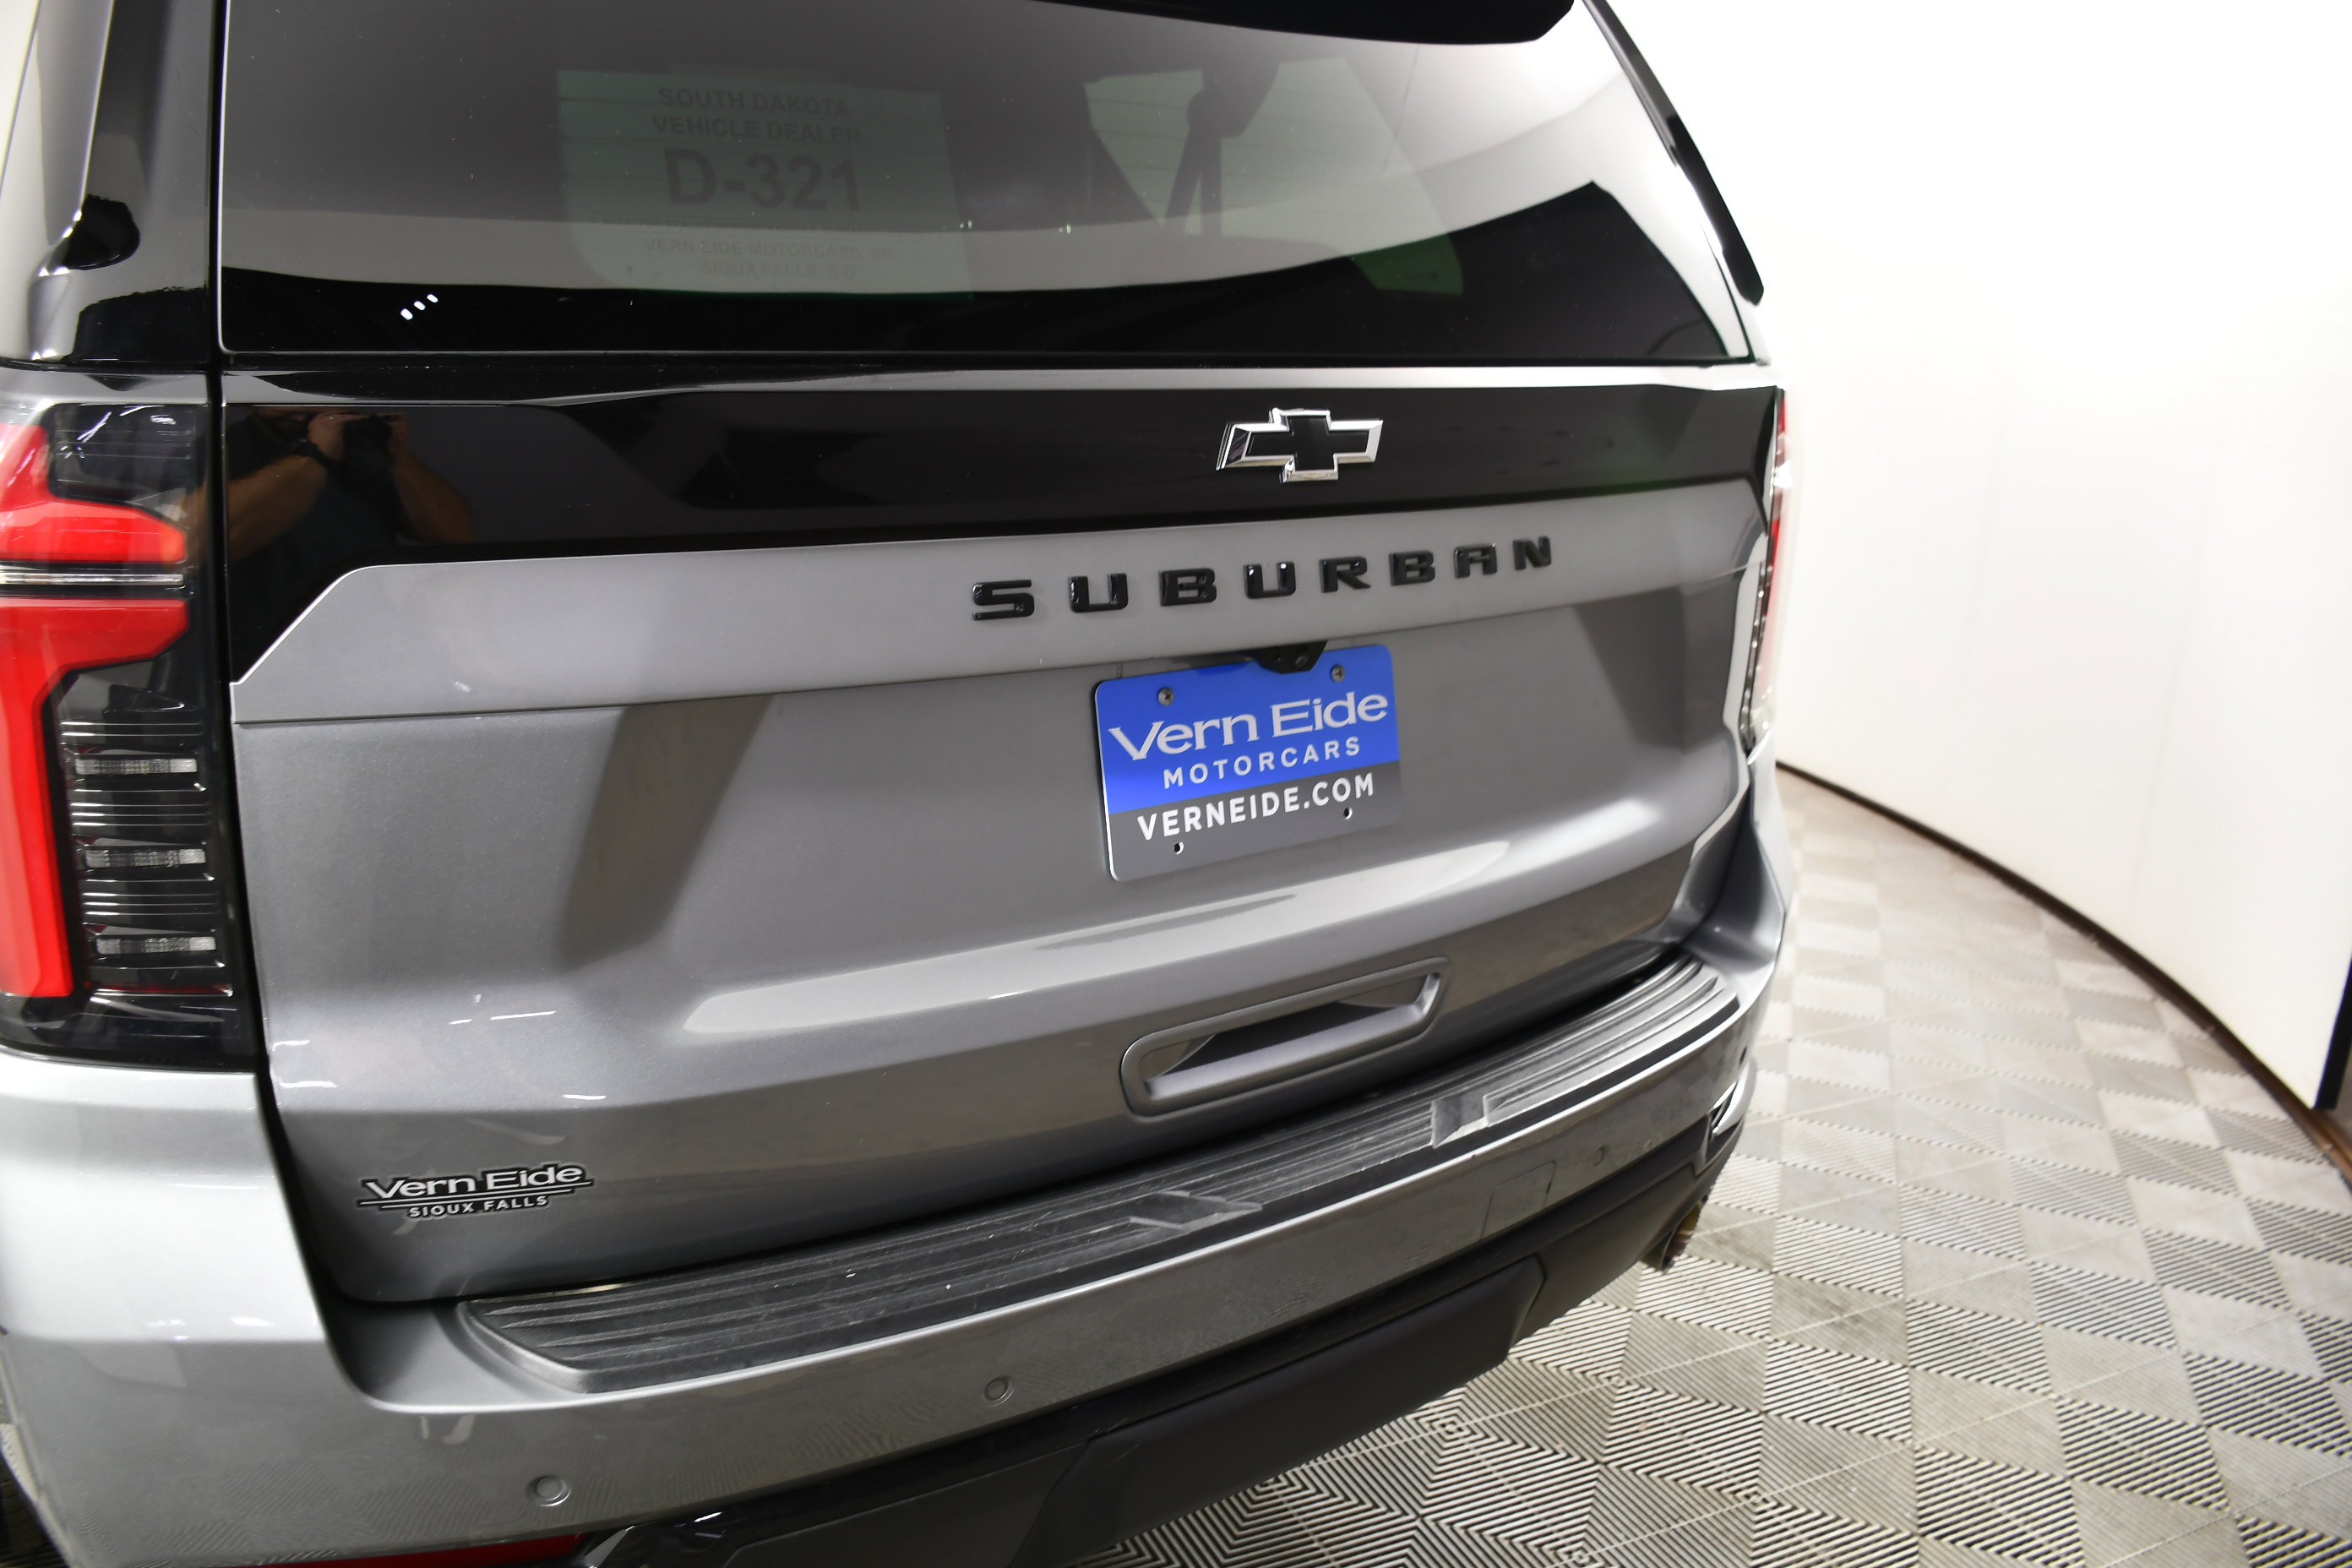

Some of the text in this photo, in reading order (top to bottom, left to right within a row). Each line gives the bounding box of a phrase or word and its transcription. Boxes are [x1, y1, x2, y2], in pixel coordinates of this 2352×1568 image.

[659, 87, 851, 117] SOUTH DAKOTA
[651, 115, 863, 145] VEHICLE DEALER
[663, 147, 859, 211] D-321
[643, 237, 696, 253] VERN
[701, 241, 743, 256] EIDE
[700, 261, 754, 277] SIOUX
[972, 536, 1552, 621] SUBURBAN
[1108, 691, 1389, 760] Vern Eide
[1163, 737, 1360, 789] MOTORCARS
[1137, 772, 1375, 841] VERNEIDE.COM
[366, 1165, 584, 1199] Vern Eide
[409, 1195, 548, 1217] SIOUX FALLS
